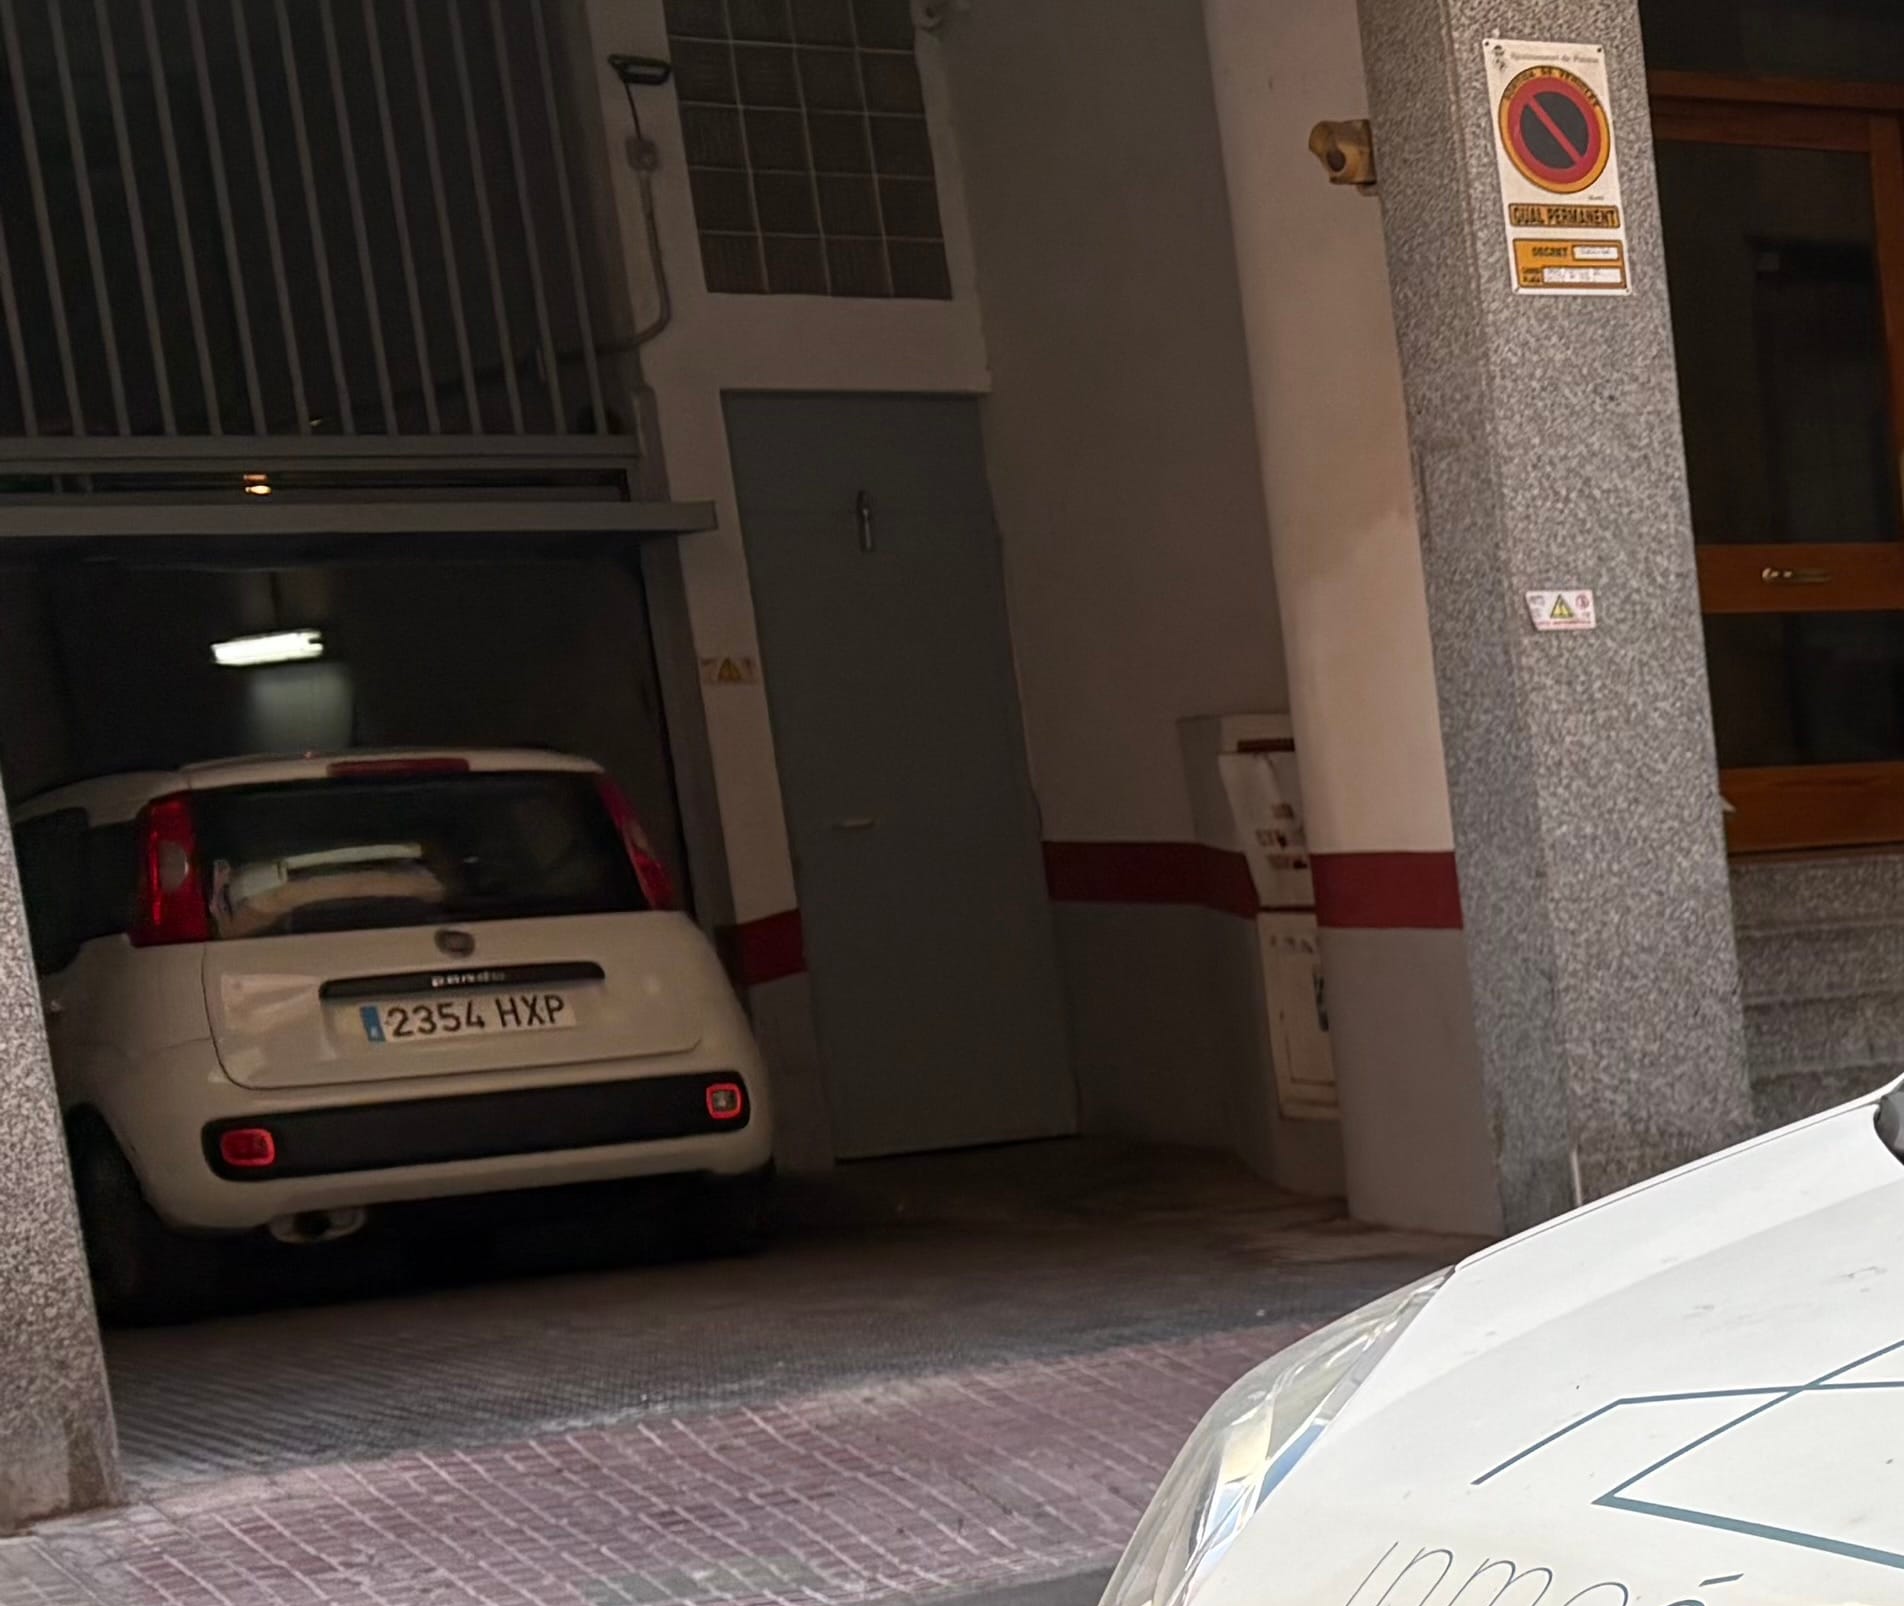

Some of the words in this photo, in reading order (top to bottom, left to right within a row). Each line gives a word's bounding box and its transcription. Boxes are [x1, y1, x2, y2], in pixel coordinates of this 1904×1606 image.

[1547, 207, 1617, 227] PERMANENT
[387, 1001, 485, 1038] 2354
[495, 994, 565, 1028] HXP
